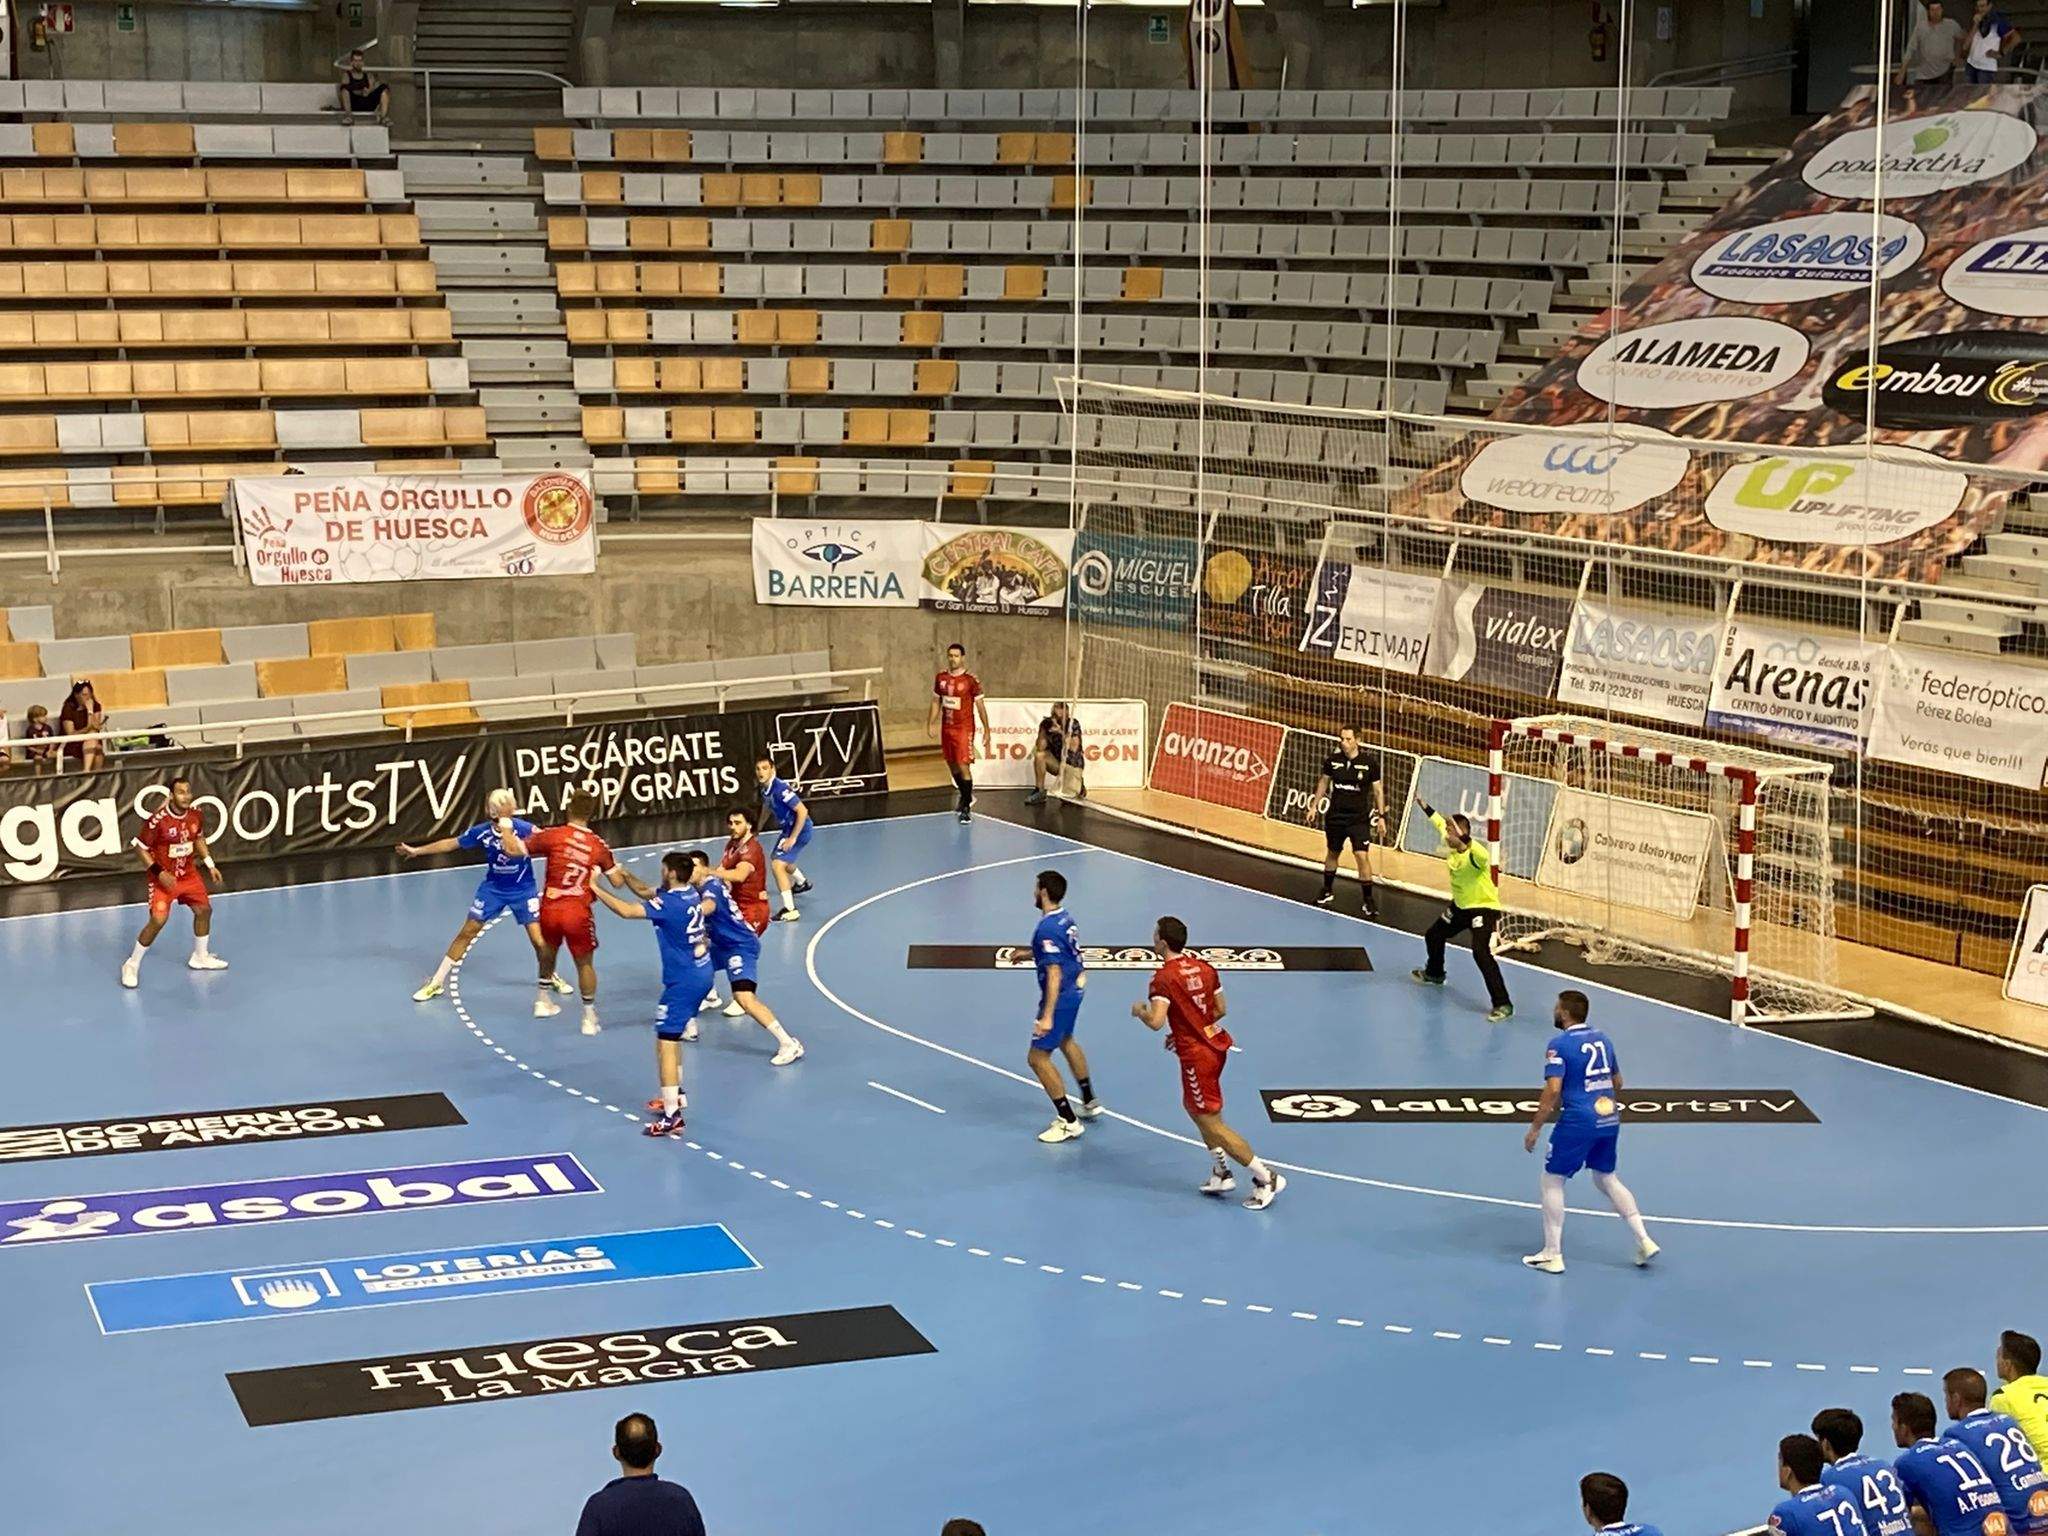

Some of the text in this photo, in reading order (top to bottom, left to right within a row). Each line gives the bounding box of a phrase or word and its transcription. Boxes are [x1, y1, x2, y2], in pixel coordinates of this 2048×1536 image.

[1718, 232, 1908, 266] LASAOSA
[1710, 265, 1790, 278] Productos
[1612, 338, 1781, 373] ALAMEDA
[1596, 365, 1763, 388] CENTRO DEPORTIVO
[1836, 362, 1987, 397] embou
[295, 486, 513, 514] PEÑA ORGULLO
[1789, 500, 1921, 524] UPLIFTING
[326, 517, 489, 543] DE HUESCA
[256, 548, 307, 566] Orgullo
[1115, 558, 1194, 586] MIGUEL
[281, 567, 332, 583] Huesca
[768, 569, 905, 599] BARREÑA
[948, 602, 965, 611] San
[966, 602, 999, 614] Lorenzo
[1018, 607, 1050, 616] Huesca
[1486, 611, 1563, 651] vialex
[1573, 614, 1716, 676] LASAOSA
[1818, 656, 1845, 670] desde
[1725, 648, 1869, 712] Arenas
[1667, 694, 1704, 712] HUESCA
[1731, 698, 1767, 715] CENTRO
[1813, 713, 1859, 730] AUDITIVO
[1954, 707, 1992, 728] Bolea
[517, 730, 724, 778] DESCÁRGATE
[804, 724, 856, 766] TV
[1164, 731, 1251, 772] avanza
[1943, 745, 1971, 760] que
[630, 766, 740, 802] GRATIS
[1581, 1041, 1611, 1076] 21
[67, 1108, 338, 1139] GOBIERNO
[71, 1134, 142, 1152] DE
[131, 1163, 575, 1228] asobal
[354, 1246, 604, 1281] LOTERÍAS
[384, 1263, 595, 1289] CON EL DEPORTE
[361, 1324, 798, 1390] Huesca
[436, 1380, 521, 1402] La
[1985, 1427, 2038, 1472] 28
[1937, 1451, 1992, 1490] 11
[1862, 1469, 1906, 1515] 43
